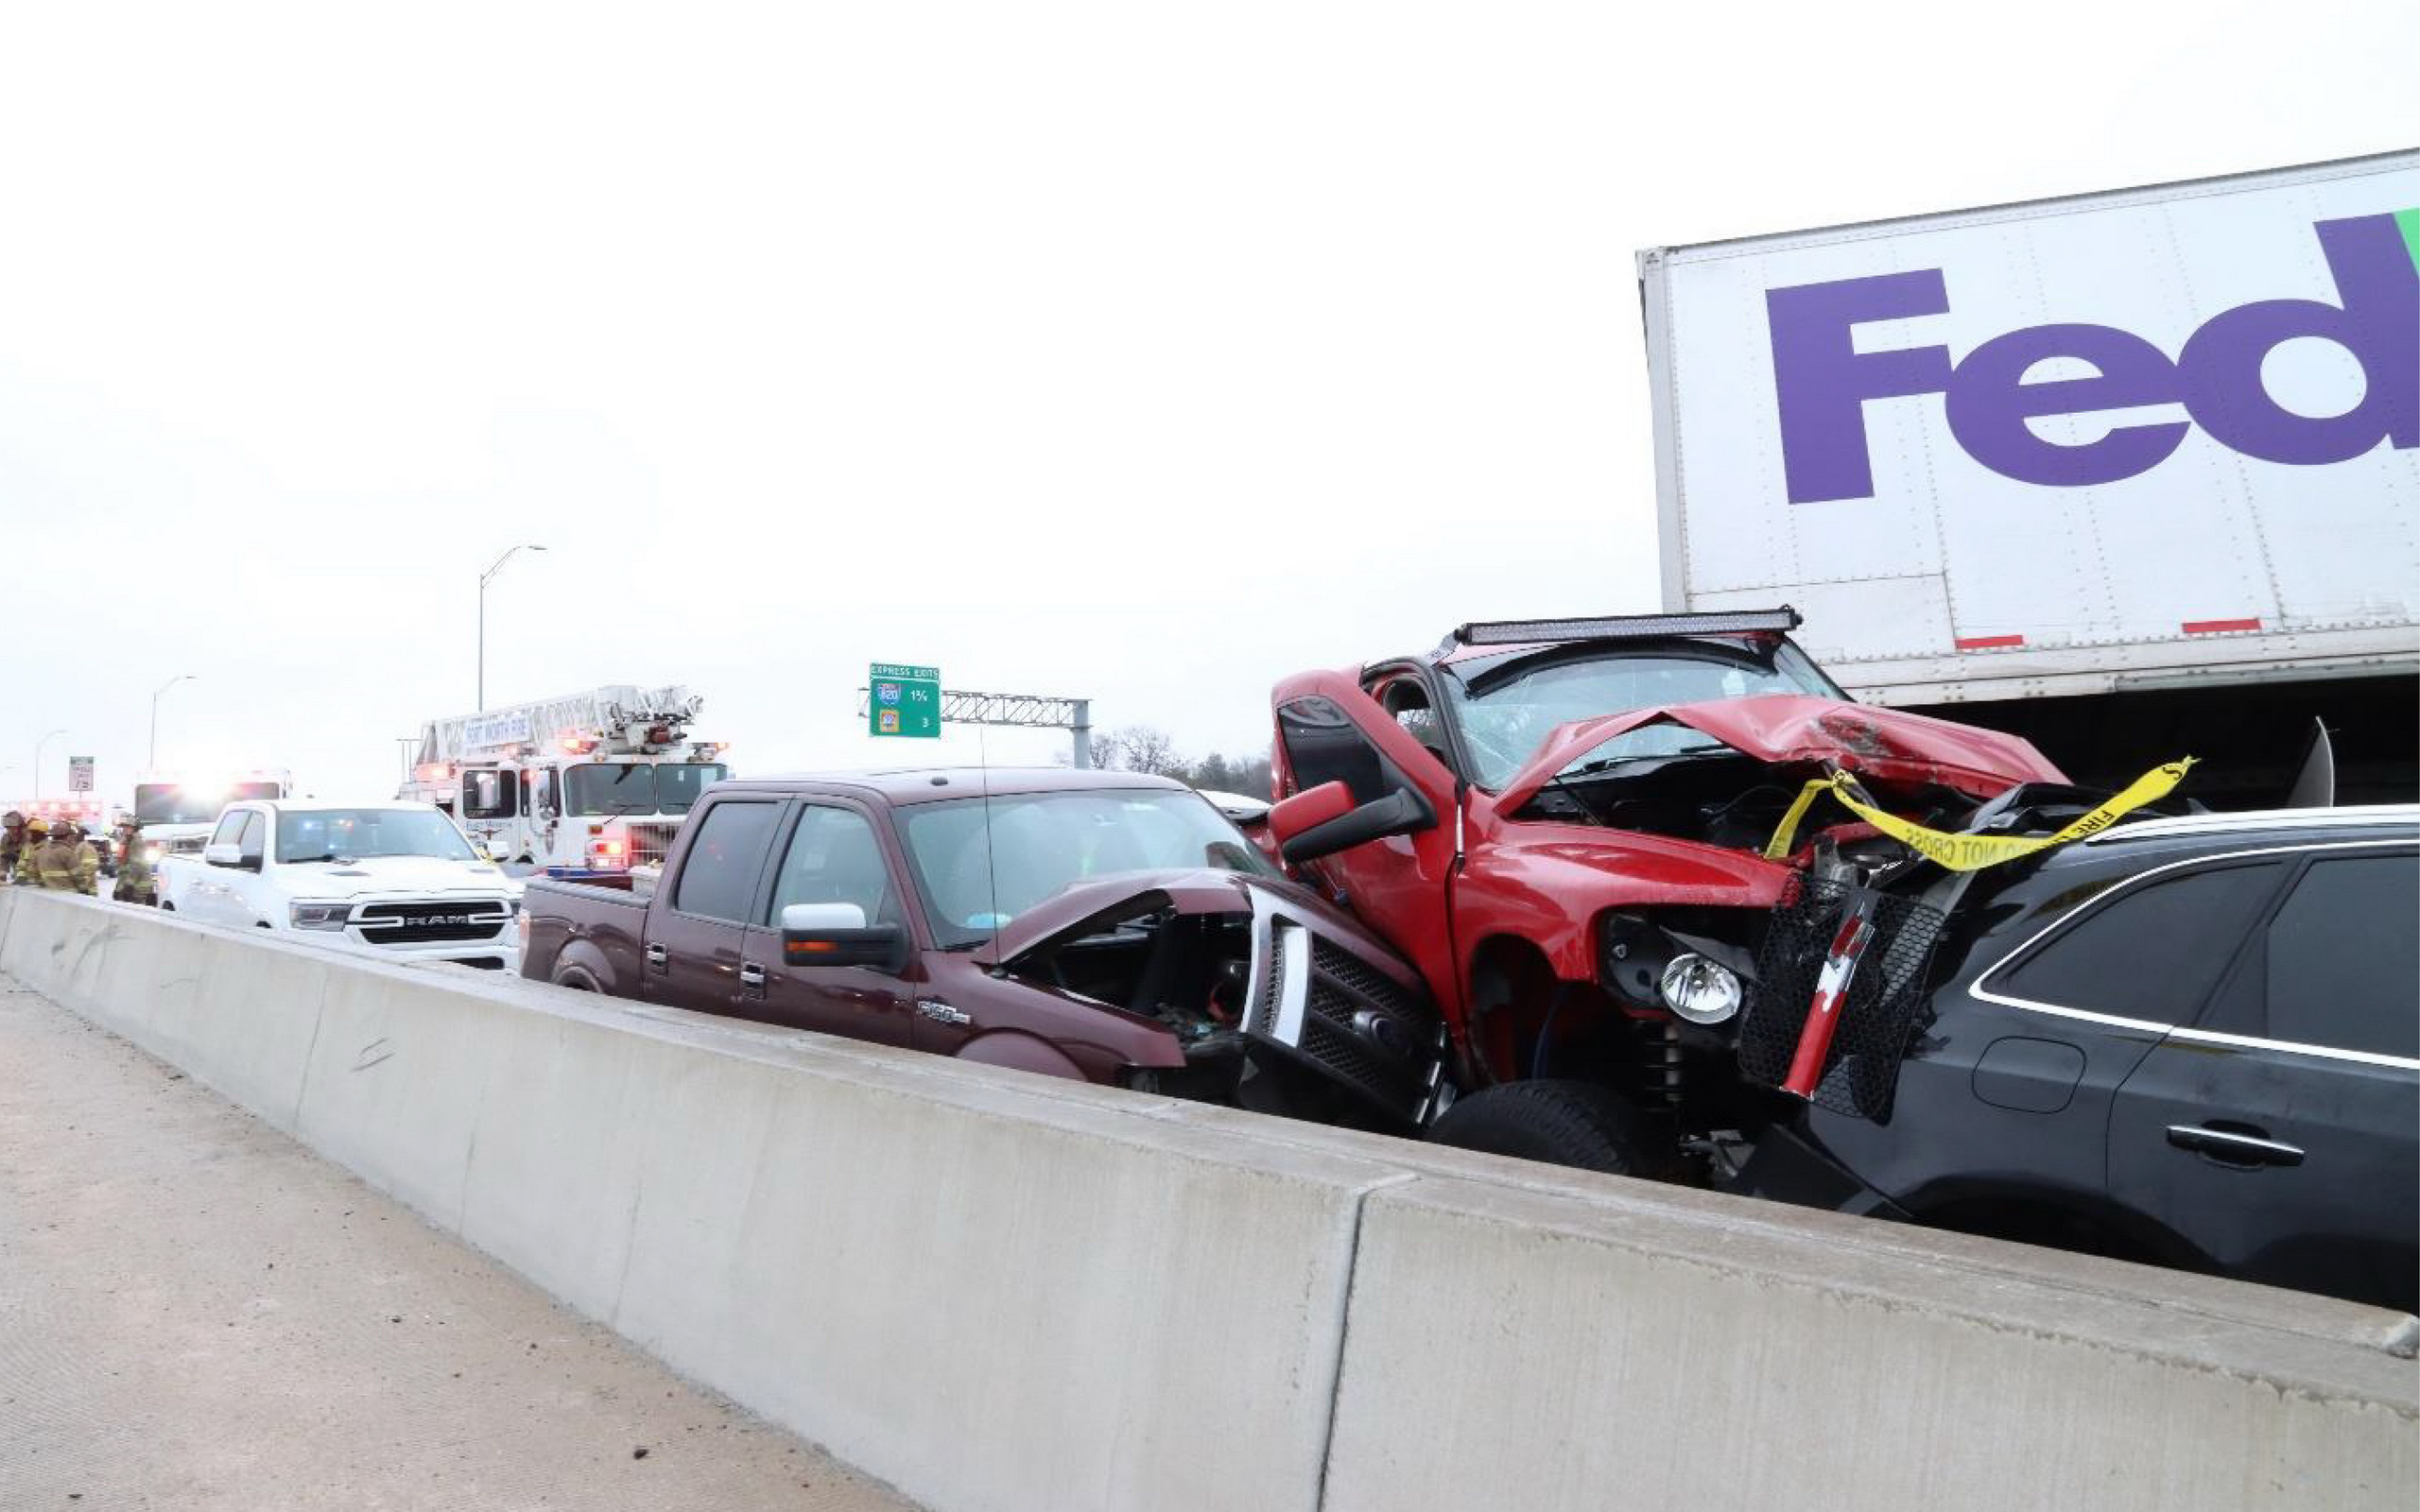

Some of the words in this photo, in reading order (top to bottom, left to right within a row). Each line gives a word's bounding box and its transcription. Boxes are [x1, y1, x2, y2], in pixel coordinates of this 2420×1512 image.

[1765, 207, 2420, 506] Fed
[872, 665, 910, 676] EXPRESS
[913, 669, 939, 679] EXITS
[406, 915, 467, 925] RAM
